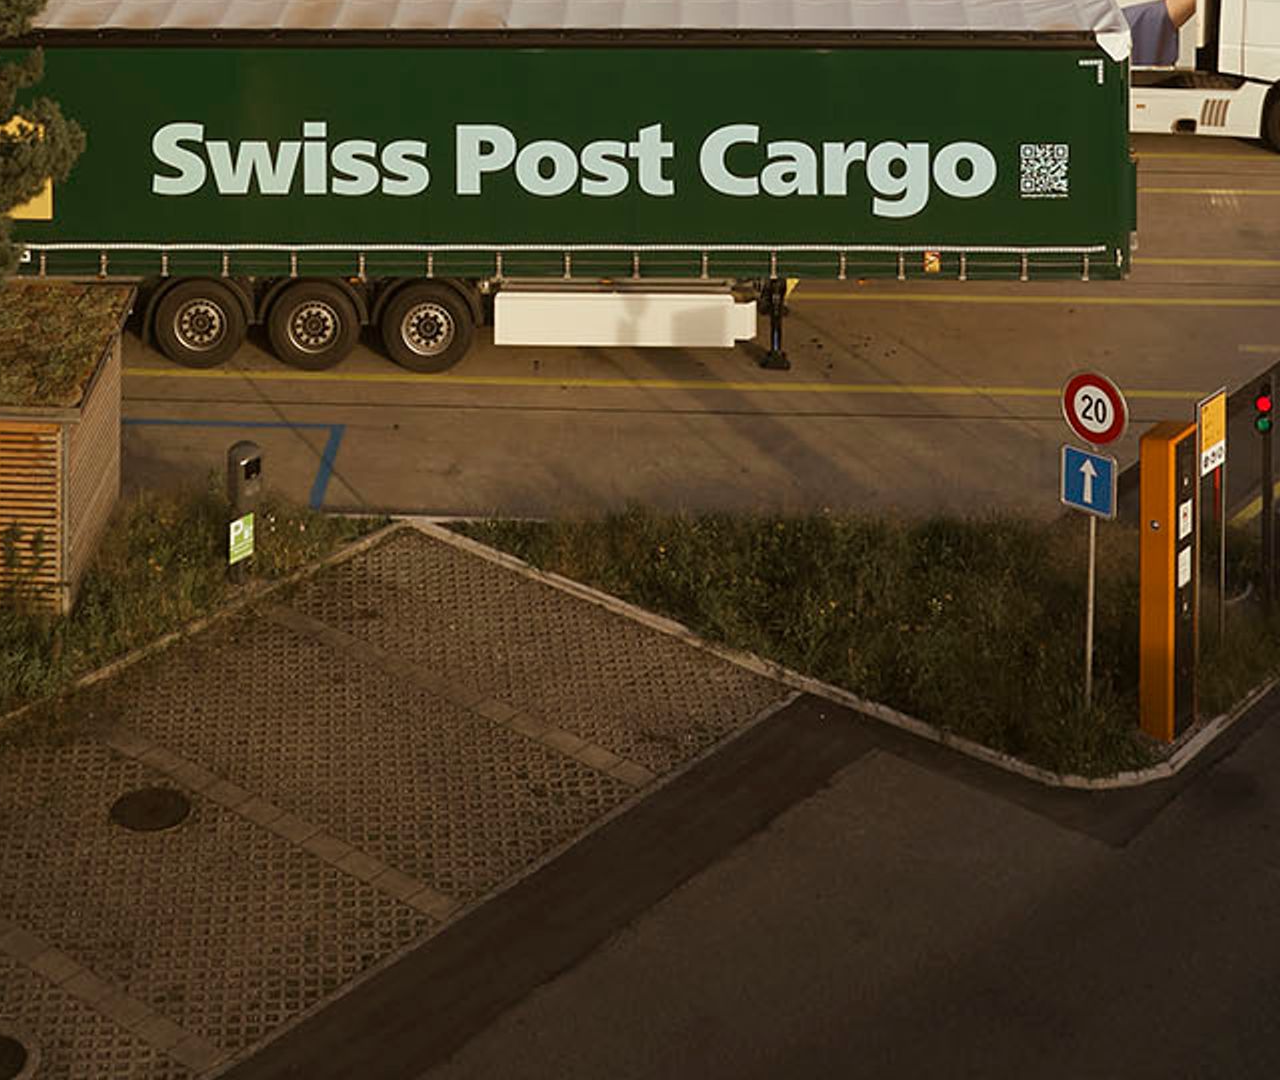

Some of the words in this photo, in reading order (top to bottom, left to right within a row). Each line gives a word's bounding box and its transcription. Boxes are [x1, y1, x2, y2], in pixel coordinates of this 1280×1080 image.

[151, 121, 431, 196] Swiss
[456, 123, 675, 196] Post
[699, 124, 998, 218] Cargo
[1081, 394, 1107, 424] 20
